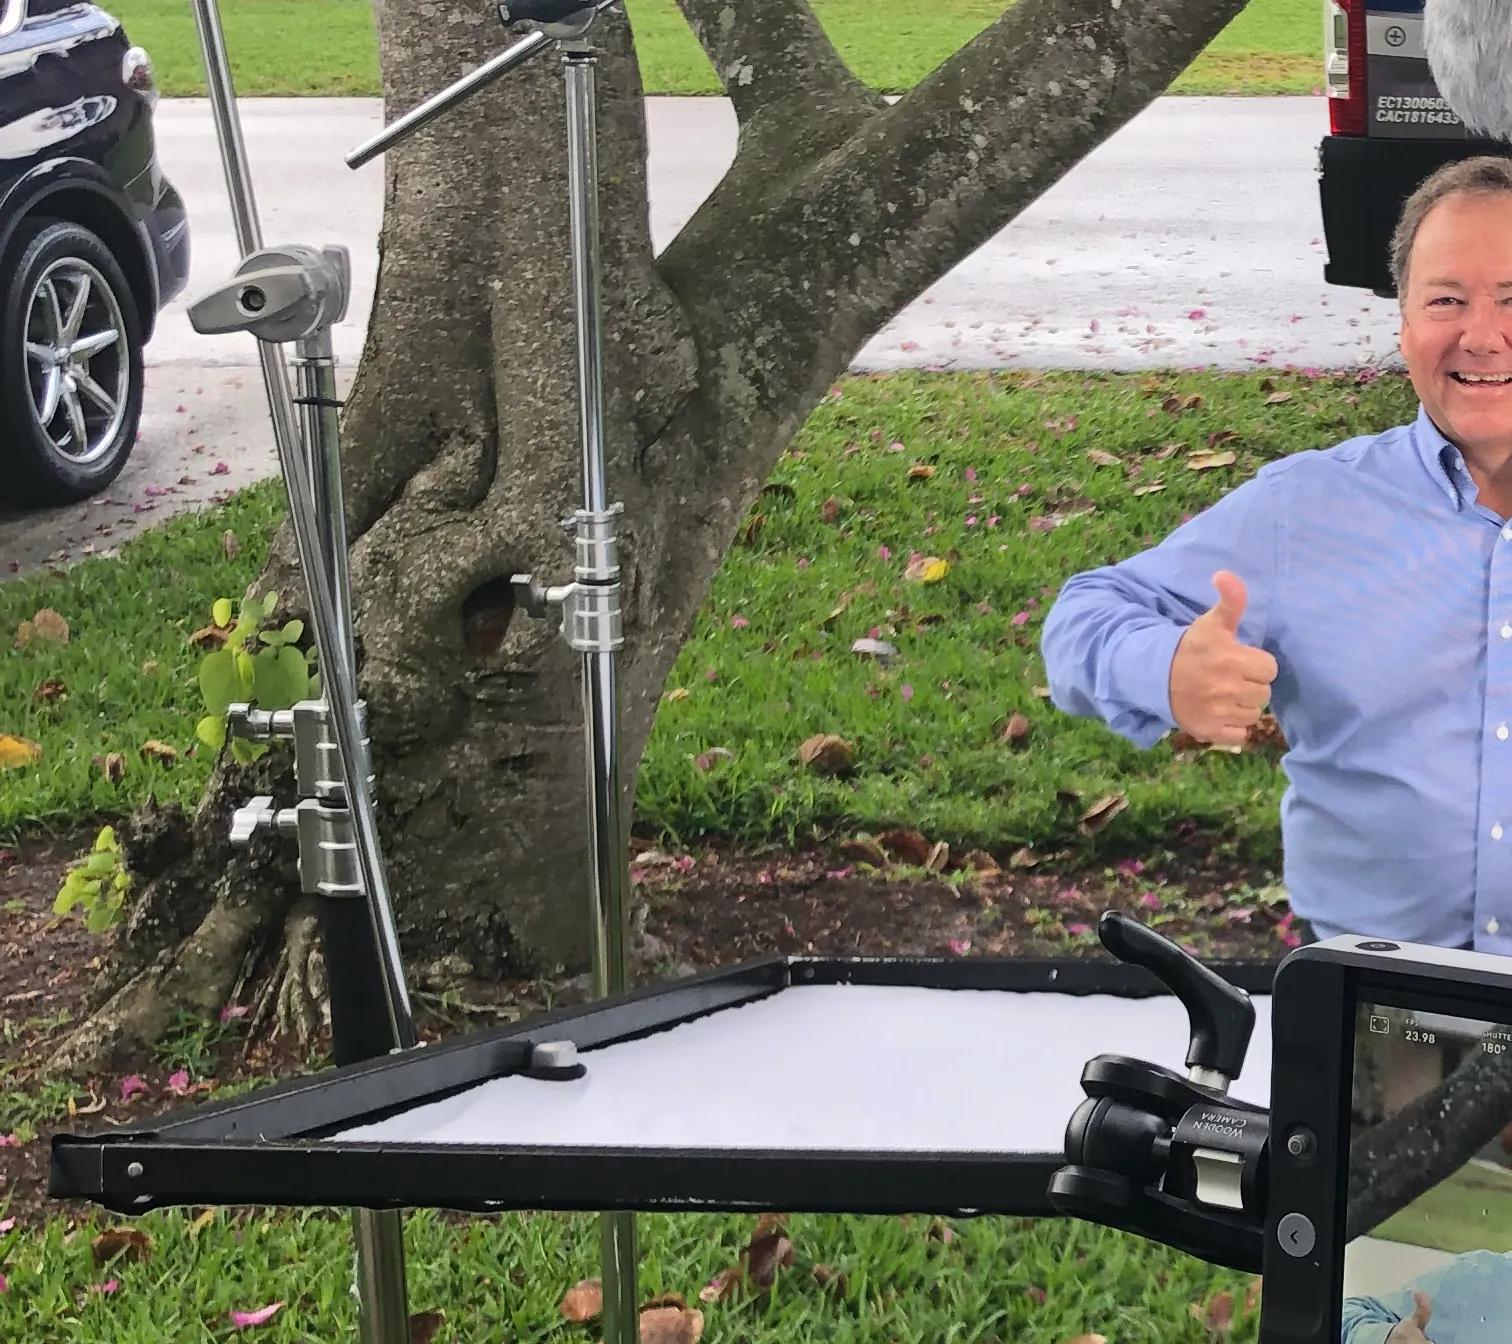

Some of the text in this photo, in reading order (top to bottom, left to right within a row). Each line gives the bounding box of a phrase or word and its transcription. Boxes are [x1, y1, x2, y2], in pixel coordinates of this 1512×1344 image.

[1405, 1030, 1436, 1045] 23.98
[1201, 1112, 1248, 1128] CAMERA
[1192, 1120, 1243, 1138] WOODEN
